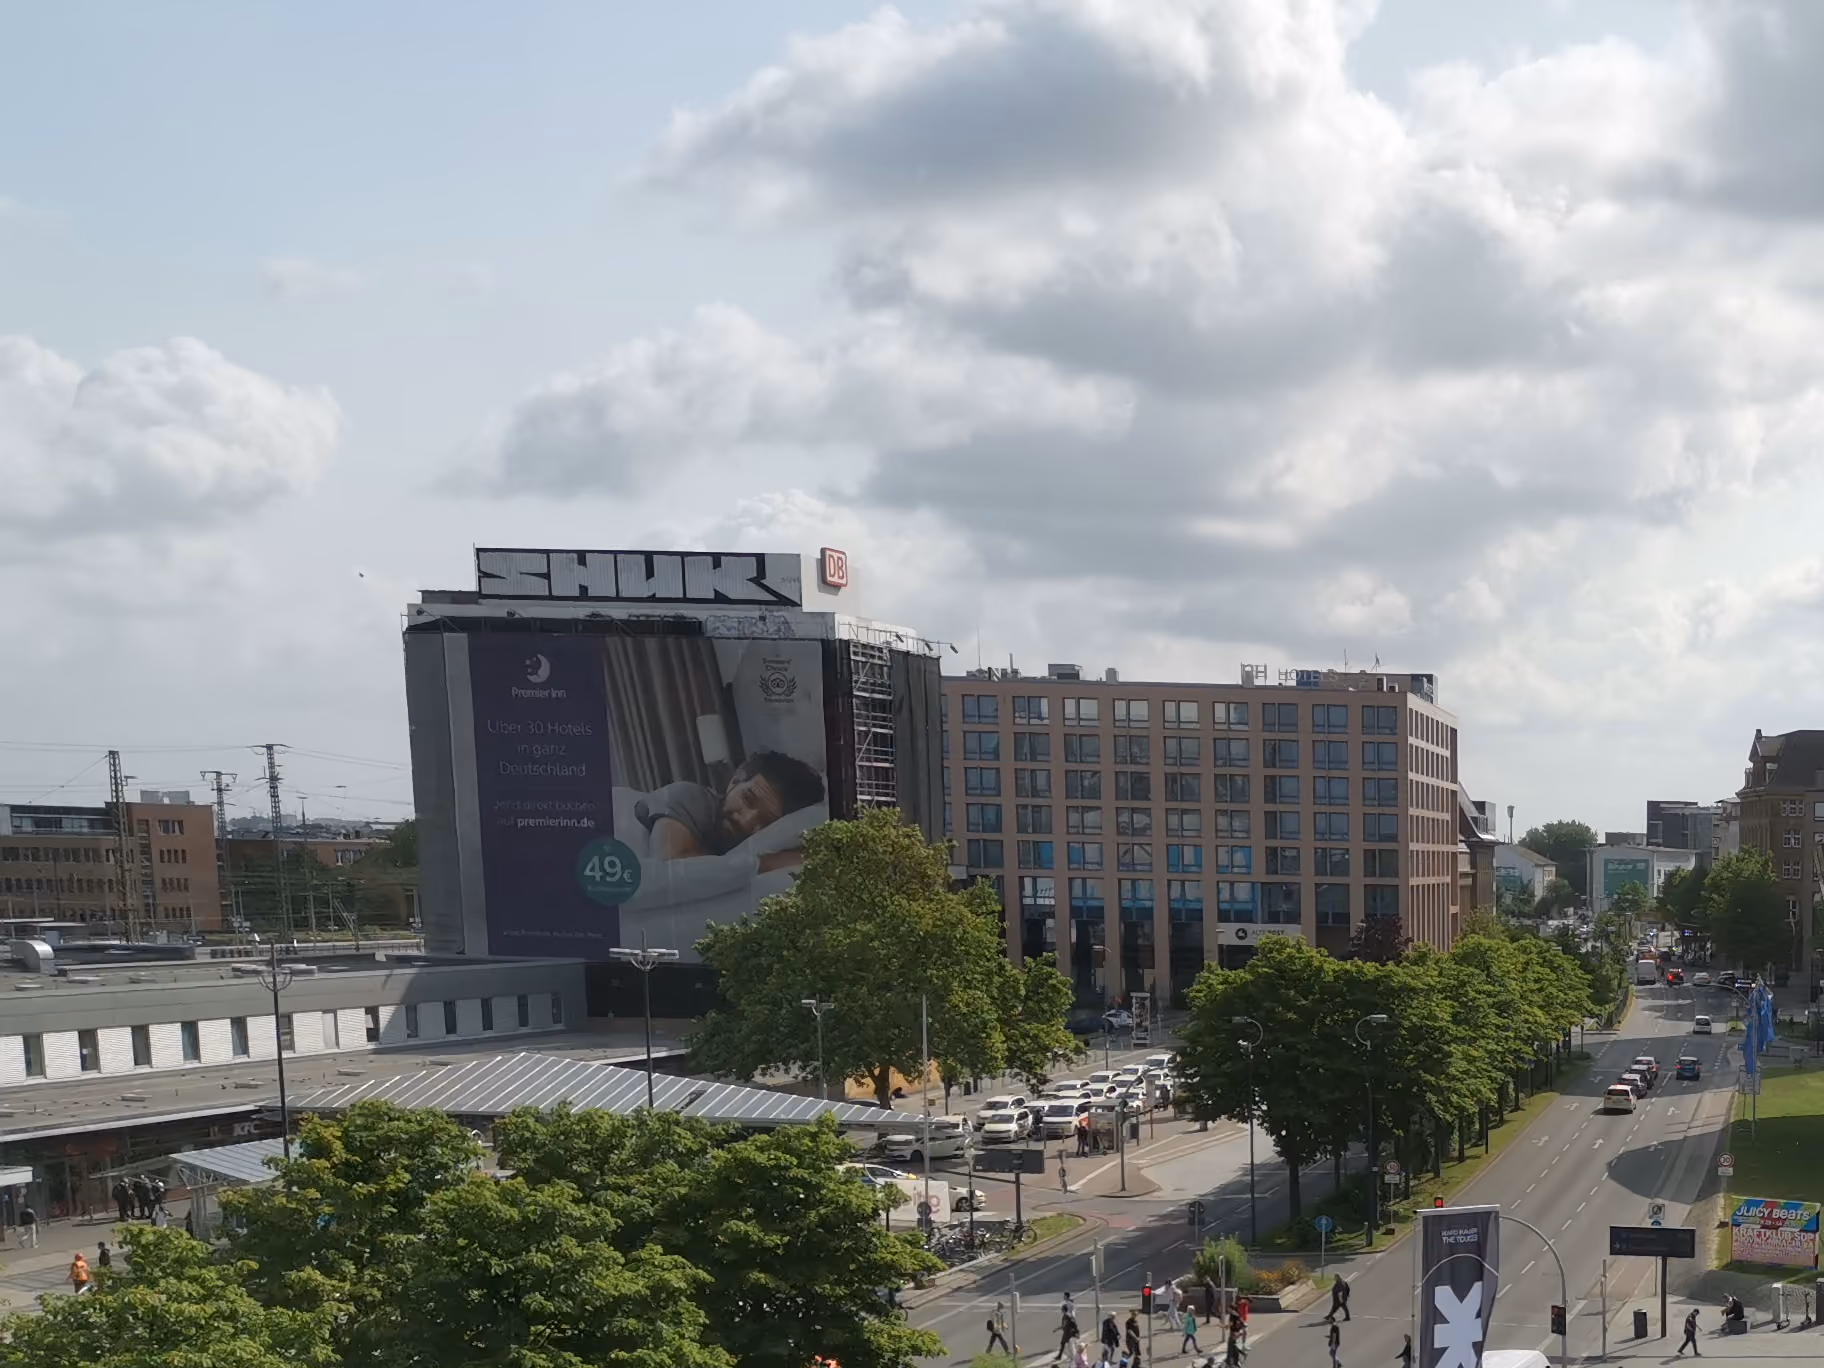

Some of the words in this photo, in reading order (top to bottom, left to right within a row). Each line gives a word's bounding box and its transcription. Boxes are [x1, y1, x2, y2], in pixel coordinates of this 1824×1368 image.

[828, 554, 844, 580] DB
[511, 687, 549, 698] Premier
[551, 688, 567, 698] Inn
[528, 721, 544, 735] 30
[548, 722, 593, 736] Hotels
[518, 745, 529, 754] in
[533, 744, 567, 758] ganz
[499, 761, 586, 776] Deutschland
[517, 817, 595, 829] premierinn.de
[233, 1120, 261, 1136] KFC
[1736, 1206, 1771, 1218] JUICY
